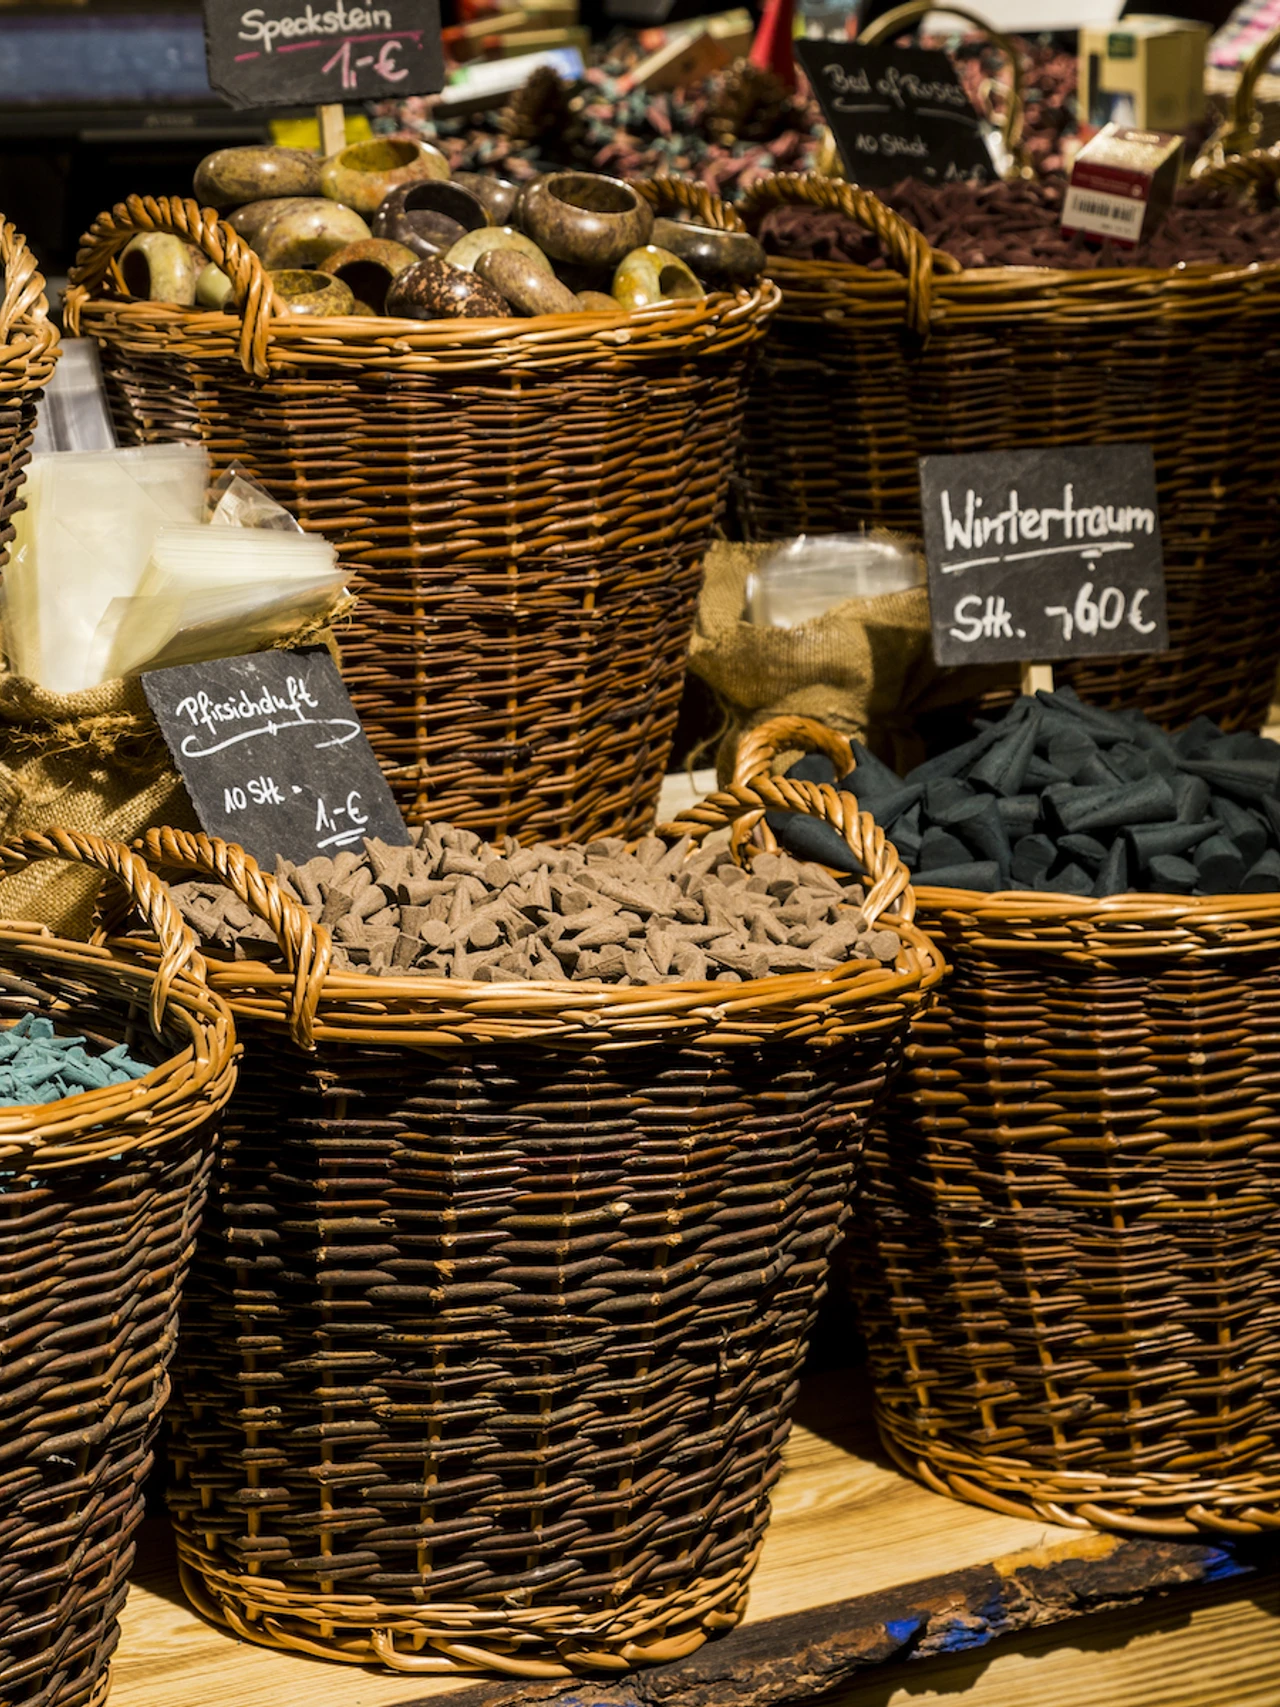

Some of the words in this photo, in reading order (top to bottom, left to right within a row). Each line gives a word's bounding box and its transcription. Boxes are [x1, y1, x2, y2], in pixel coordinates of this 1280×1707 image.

[238, 0, 392, 53] Speckstein
[823, 64, 870, 93] Bed
[876, 66, 905, 109] of
[855, 133, 878, 155] 10
[940, 482, 1155, 551] Wintertraum
[949, 594, 1027, 643] Stk.
[175, 675, 319, 736] Pfirsichduft
[223, 786, 248, 814] 10
[246, 775, 286, 805] Stk
